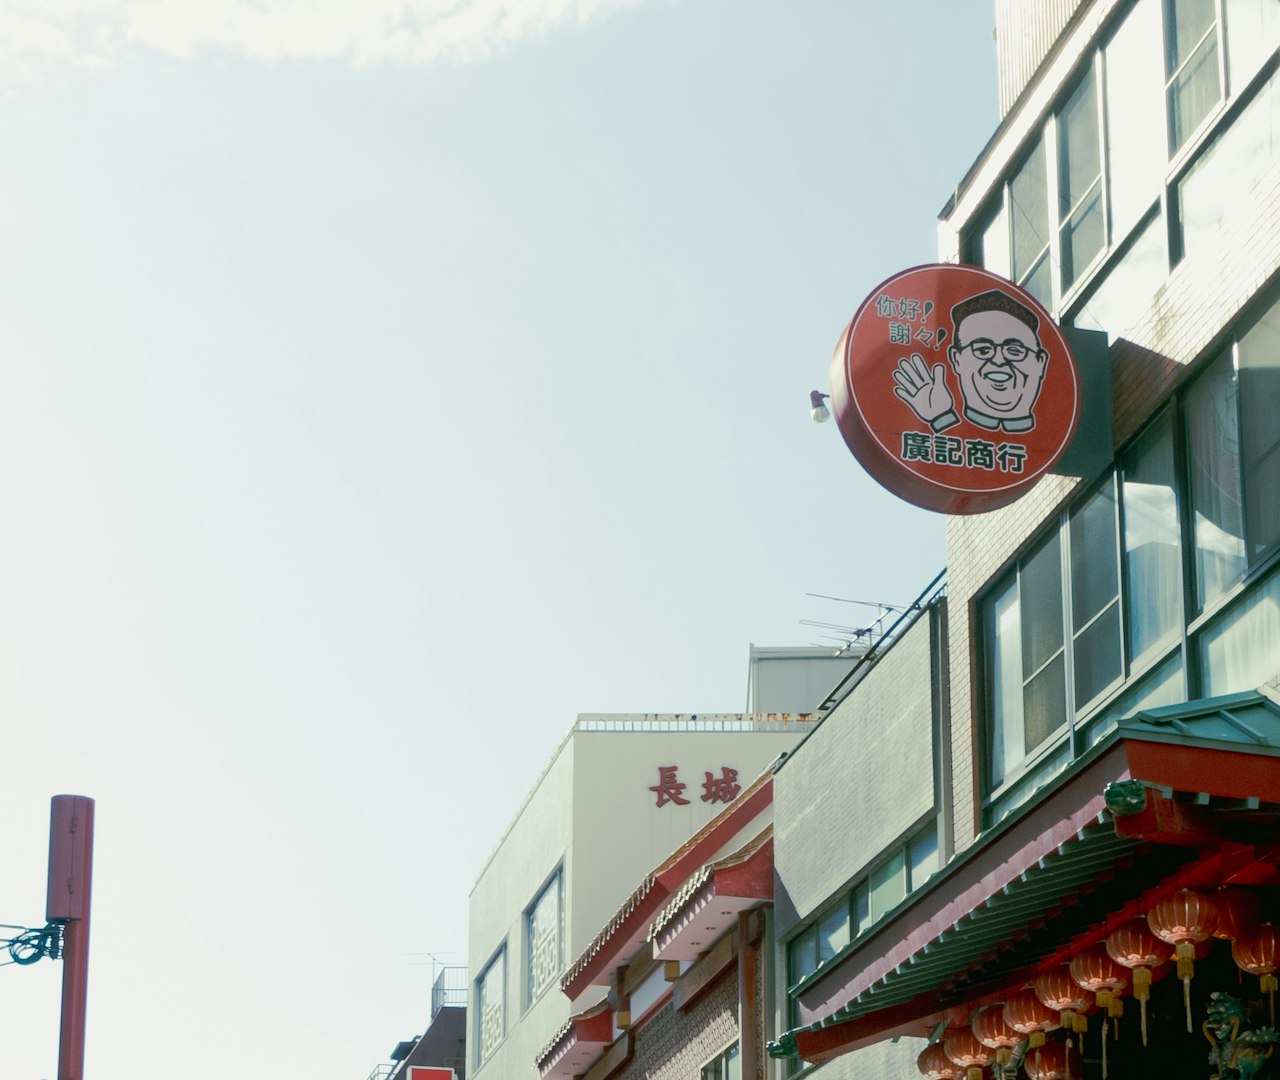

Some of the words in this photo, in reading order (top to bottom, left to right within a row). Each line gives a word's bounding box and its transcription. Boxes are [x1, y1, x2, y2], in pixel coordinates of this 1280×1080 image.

[900, 431, 1028, 475] 廣記商行
[649, 765, 741, 808] 長城
